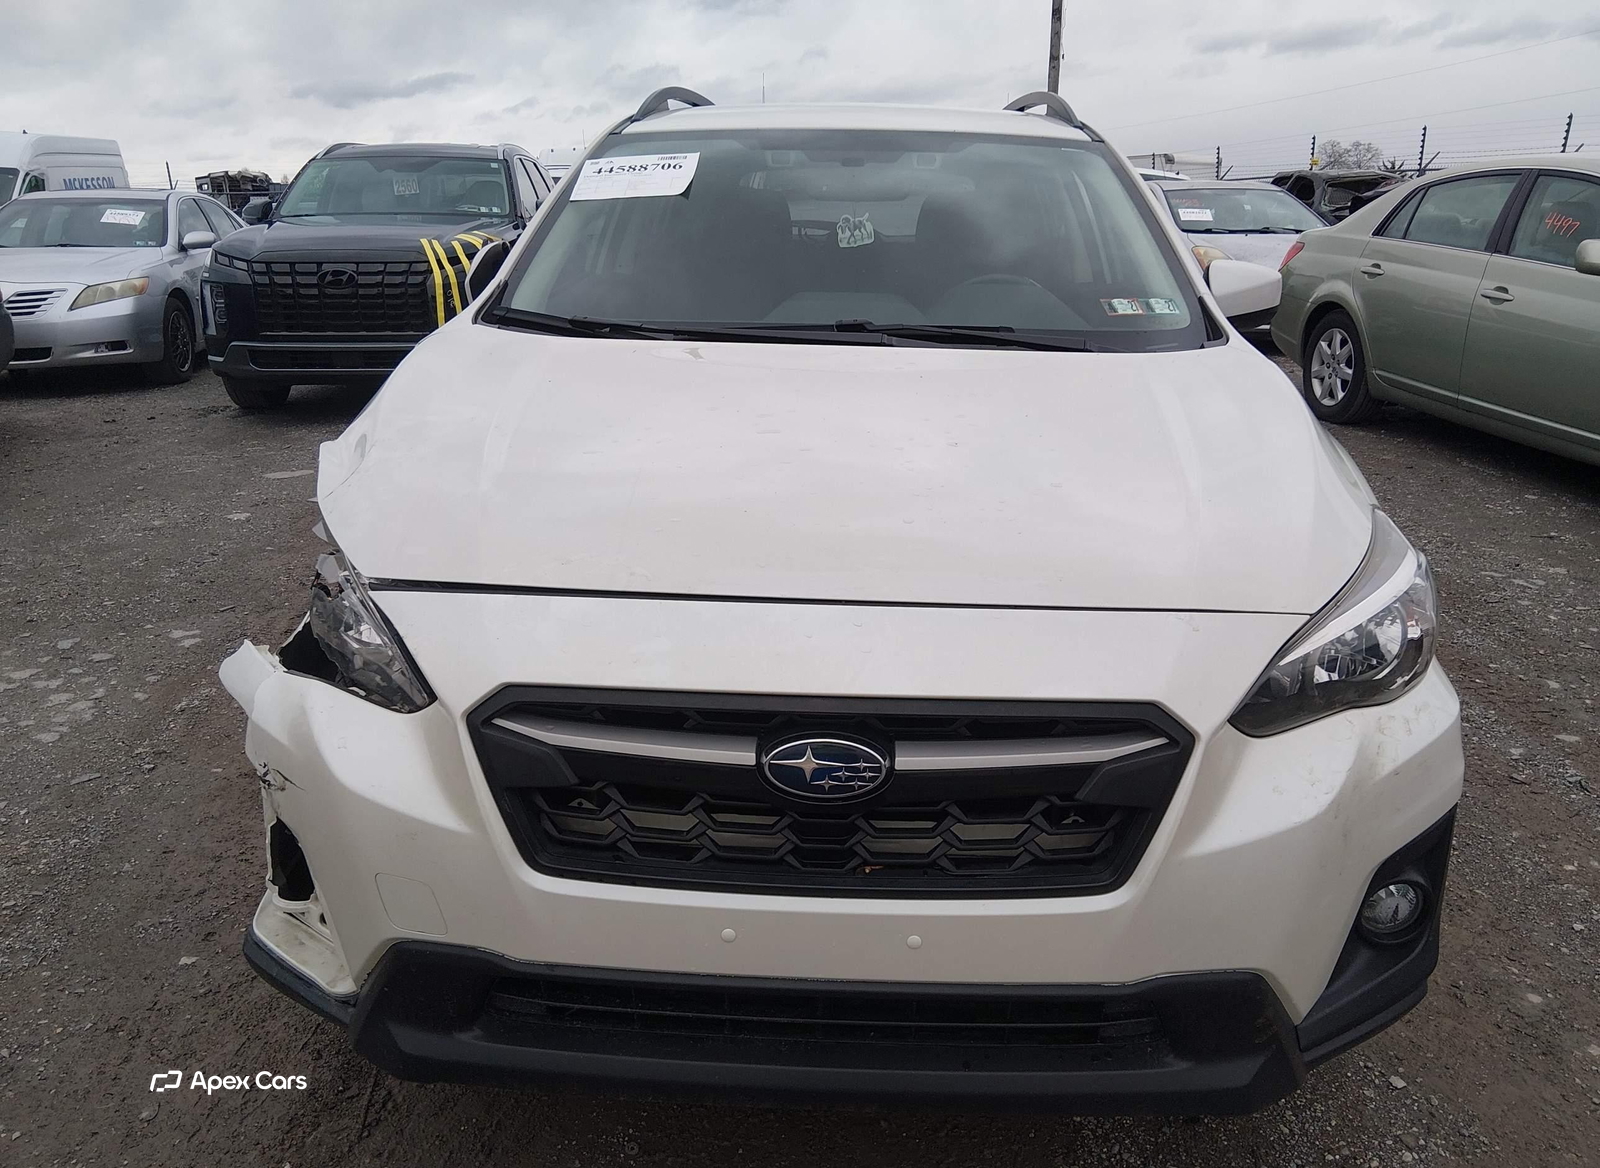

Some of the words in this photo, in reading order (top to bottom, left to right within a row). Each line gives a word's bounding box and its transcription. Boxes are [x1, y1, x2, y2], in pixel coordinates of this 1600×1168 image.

[592, 162, 684, 175] 44588706
[396, 179, 418, 194] 2560
[1545, 211, 1580, 239] 4497
